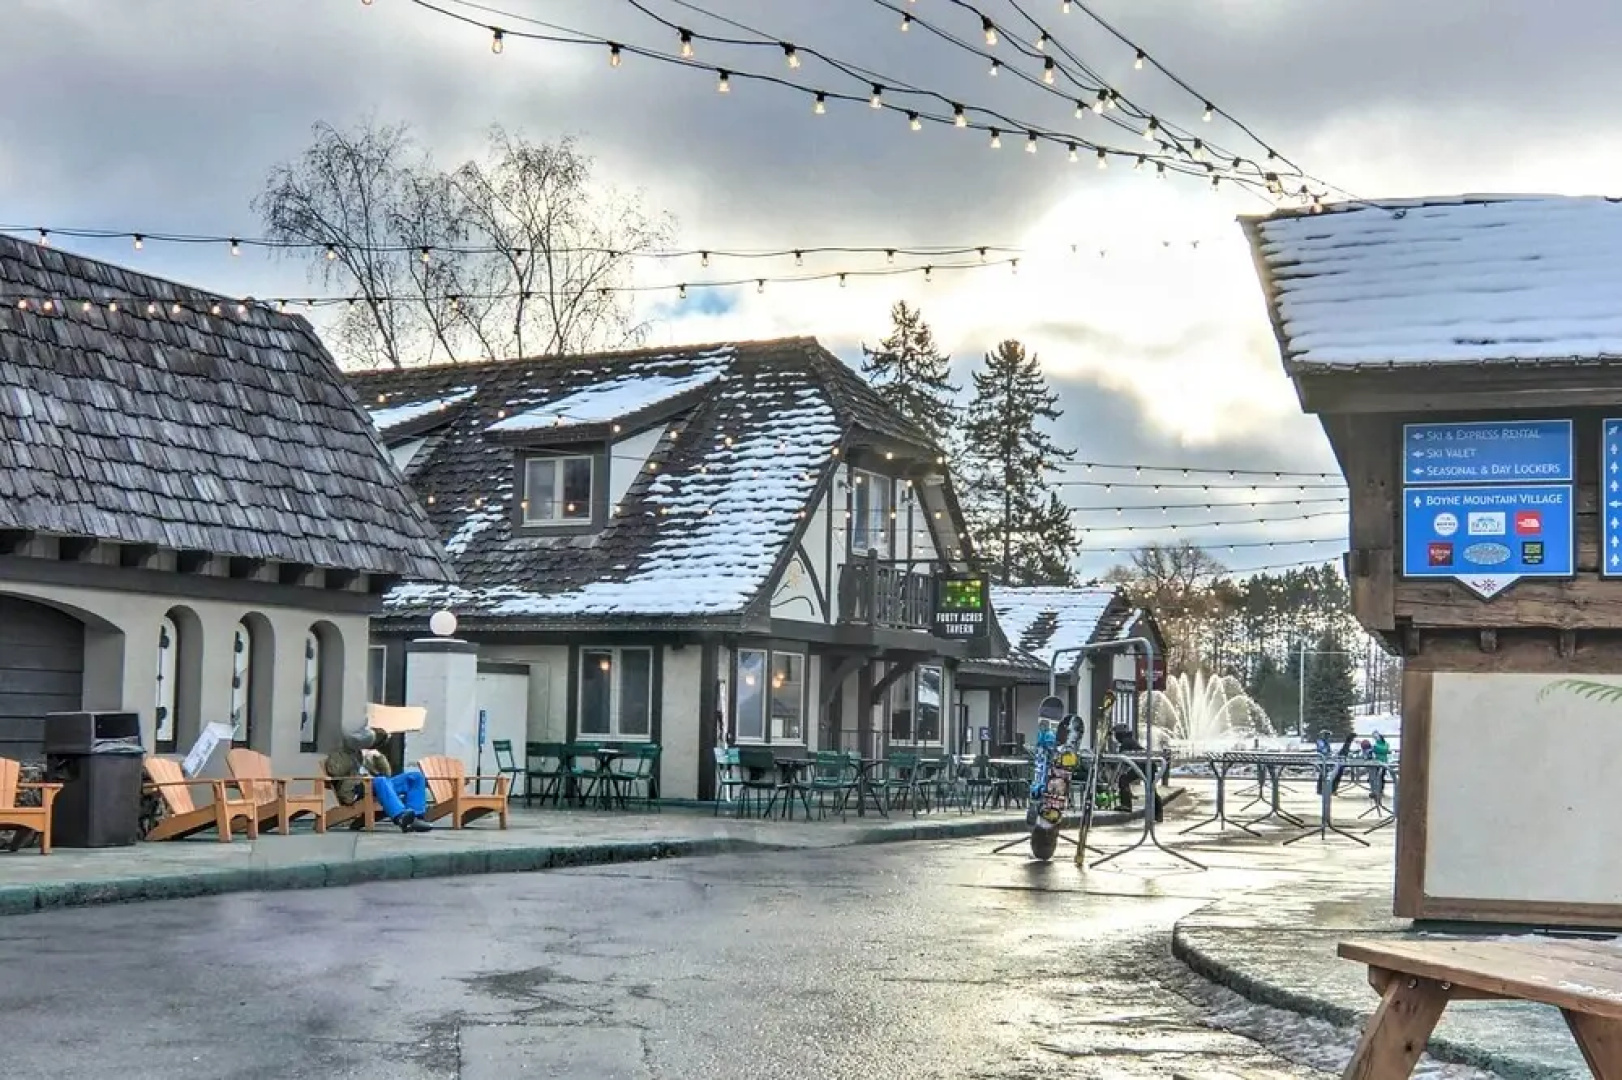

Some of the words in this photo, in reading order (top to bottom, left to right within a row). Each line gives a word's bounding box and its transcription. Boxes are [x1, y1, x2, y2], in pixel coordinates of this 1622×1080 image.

[1427, 431, 1443, 441] SKI
[1446, 431, 1453, 440] &
[1456, 429, 1499, 440] EXPRESS
[1502, 428, 1541, 439] RENTAL
[1427, 448, 1443, 458] SKI
[1446, 448, 1477, 458] VALET
[1427, 466, 1478, 476] SEASONAL
[1480, 466, 1488, 475] &
[1491, 465, 1512, 475] DAY
[1515, 463, 1560, 474] LOCKERS
[1427, 496, 1460, 506] BOYNE
[1463, 495, 1516, 505] MOUNTAIN
[1520, 494, 1563, 504] VILLAGE
[961, 613, 983, 622] ACRES
[946, 624, 974, 634] TAVERN
